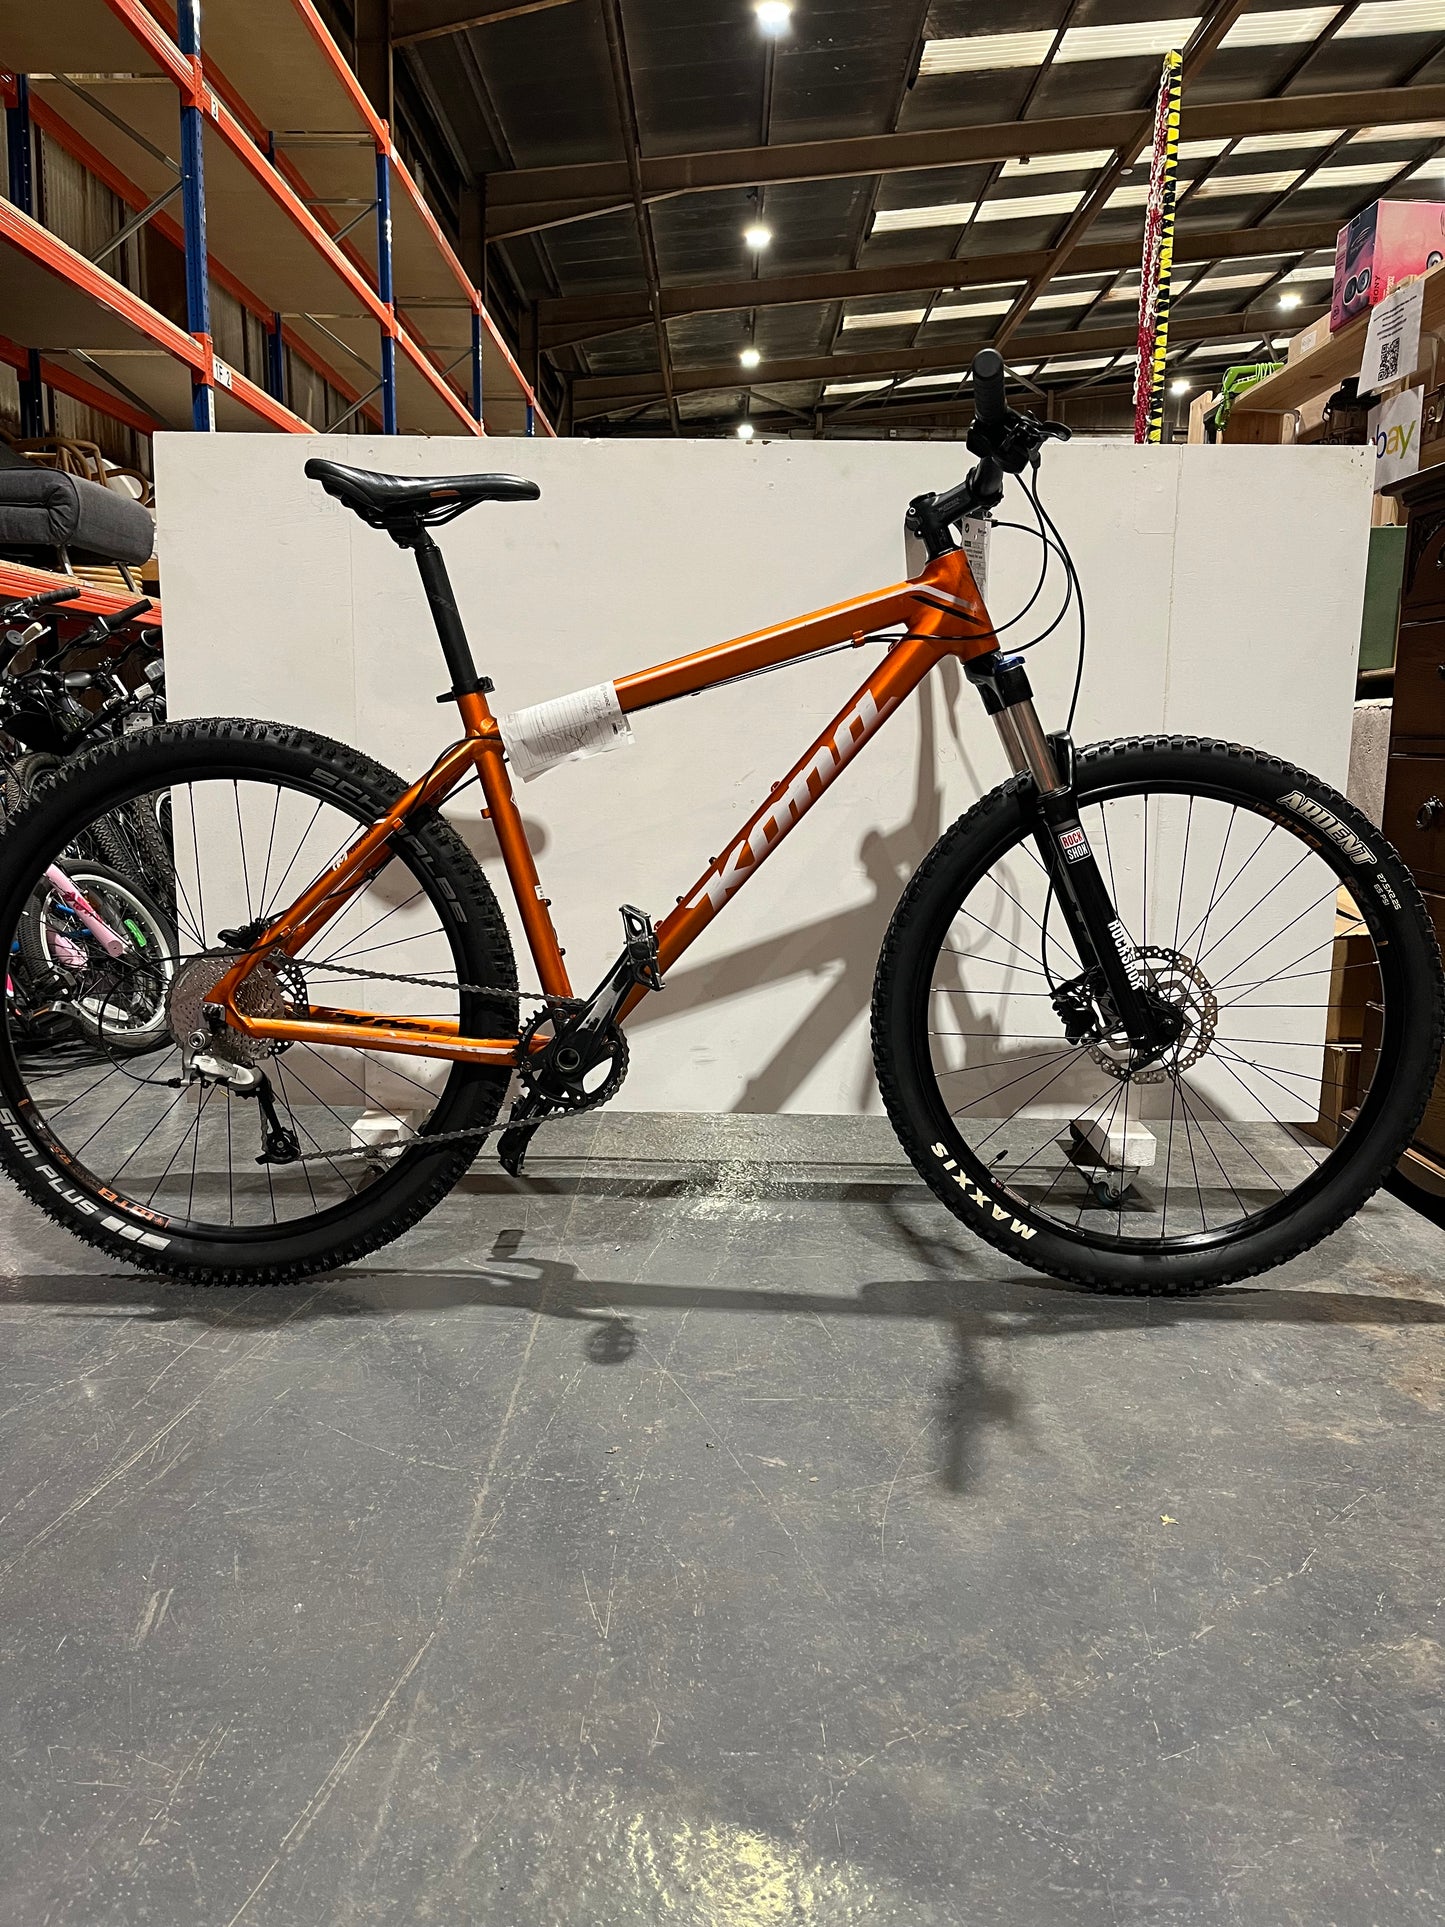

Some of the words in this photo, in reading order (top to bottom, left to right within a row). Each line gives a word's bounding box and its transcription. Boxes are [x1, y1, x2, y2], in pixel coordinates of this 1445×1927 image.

[1373, 275, 1381, 303] SONY
[1371, 420, 1417, 459] bay
[1061, 831, 1083, 848] ROCK
[1276, 789, 1378, 865] ARDENT
[1067, 843, 1089, 860] SHOX
[1373, 883, 1384, 894] 65
[1380, 893, 1390, 906] PSI
[1376, 872, 1402, 911] 27.5X2.25
[1107, 919, 1142, 991] ROCKSHOX
[0, 1107, 40, 1159] SAM
[35, 1164, 100, 1216] PLUS
[931, 1141, 1038, 1241] MAXXIS
